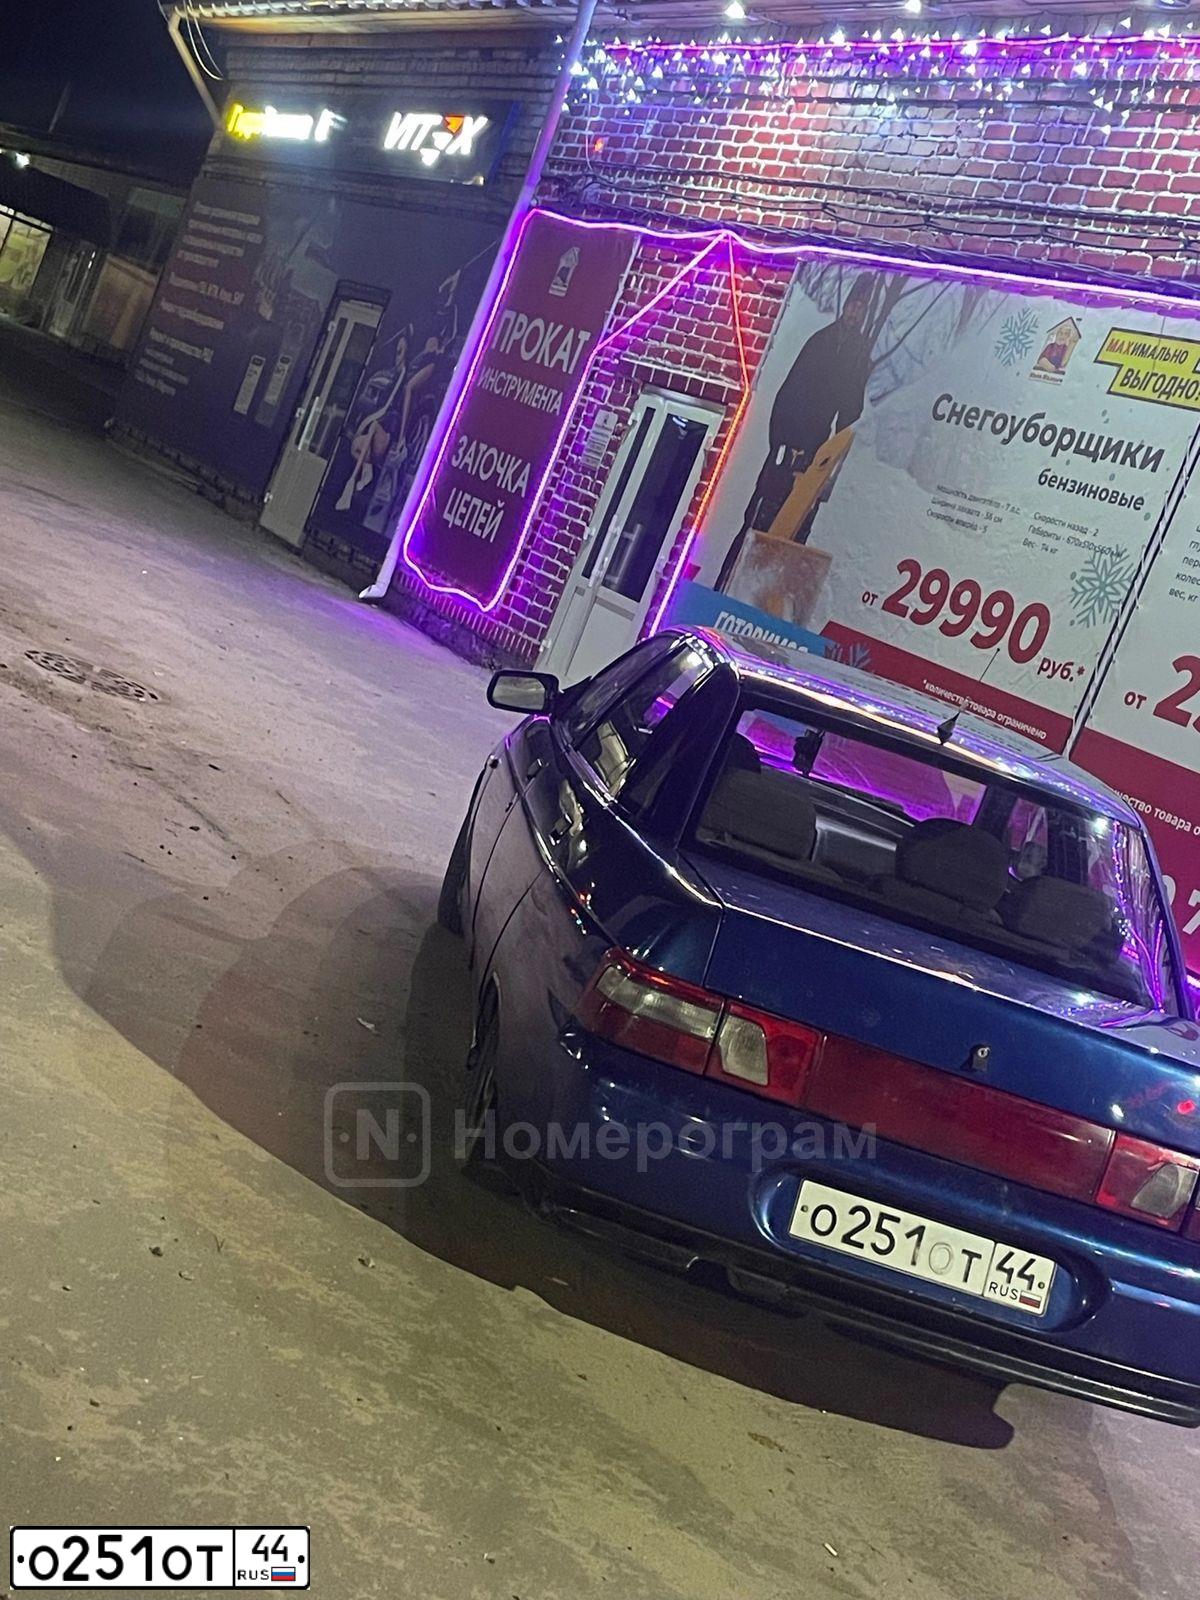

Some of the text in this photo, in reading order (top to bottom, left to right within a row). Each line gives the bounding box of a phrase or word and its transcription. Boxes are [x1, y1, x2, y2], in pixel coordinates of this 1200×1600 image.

[492, 309, 591, 375] ПРОКАТ
[1105, 337, 1189, 365] МАХИМАЛЬНО
[478, 366, 563, 416] ИНСТРУМЕНТА
[932, 392, 1166, 474] Снегоуборщики
[451, 434, 531, 498] ЗАТОЧКА
[1037, 468, 1145, 511] бензиновые
[443, 487, 505, 544] ЦЕПЕЙ
[861, 591, 879, 606] от
[881, 558, 1051, 664] 29990
[1124, 691, 1147, 709] от
[996, 713, 1047, 740] ограничено
[1154, 808, 1192, 832] товара
[988, 1281, 1019, 1300] RUS
[996, 1251, 1036, 1291] 44
